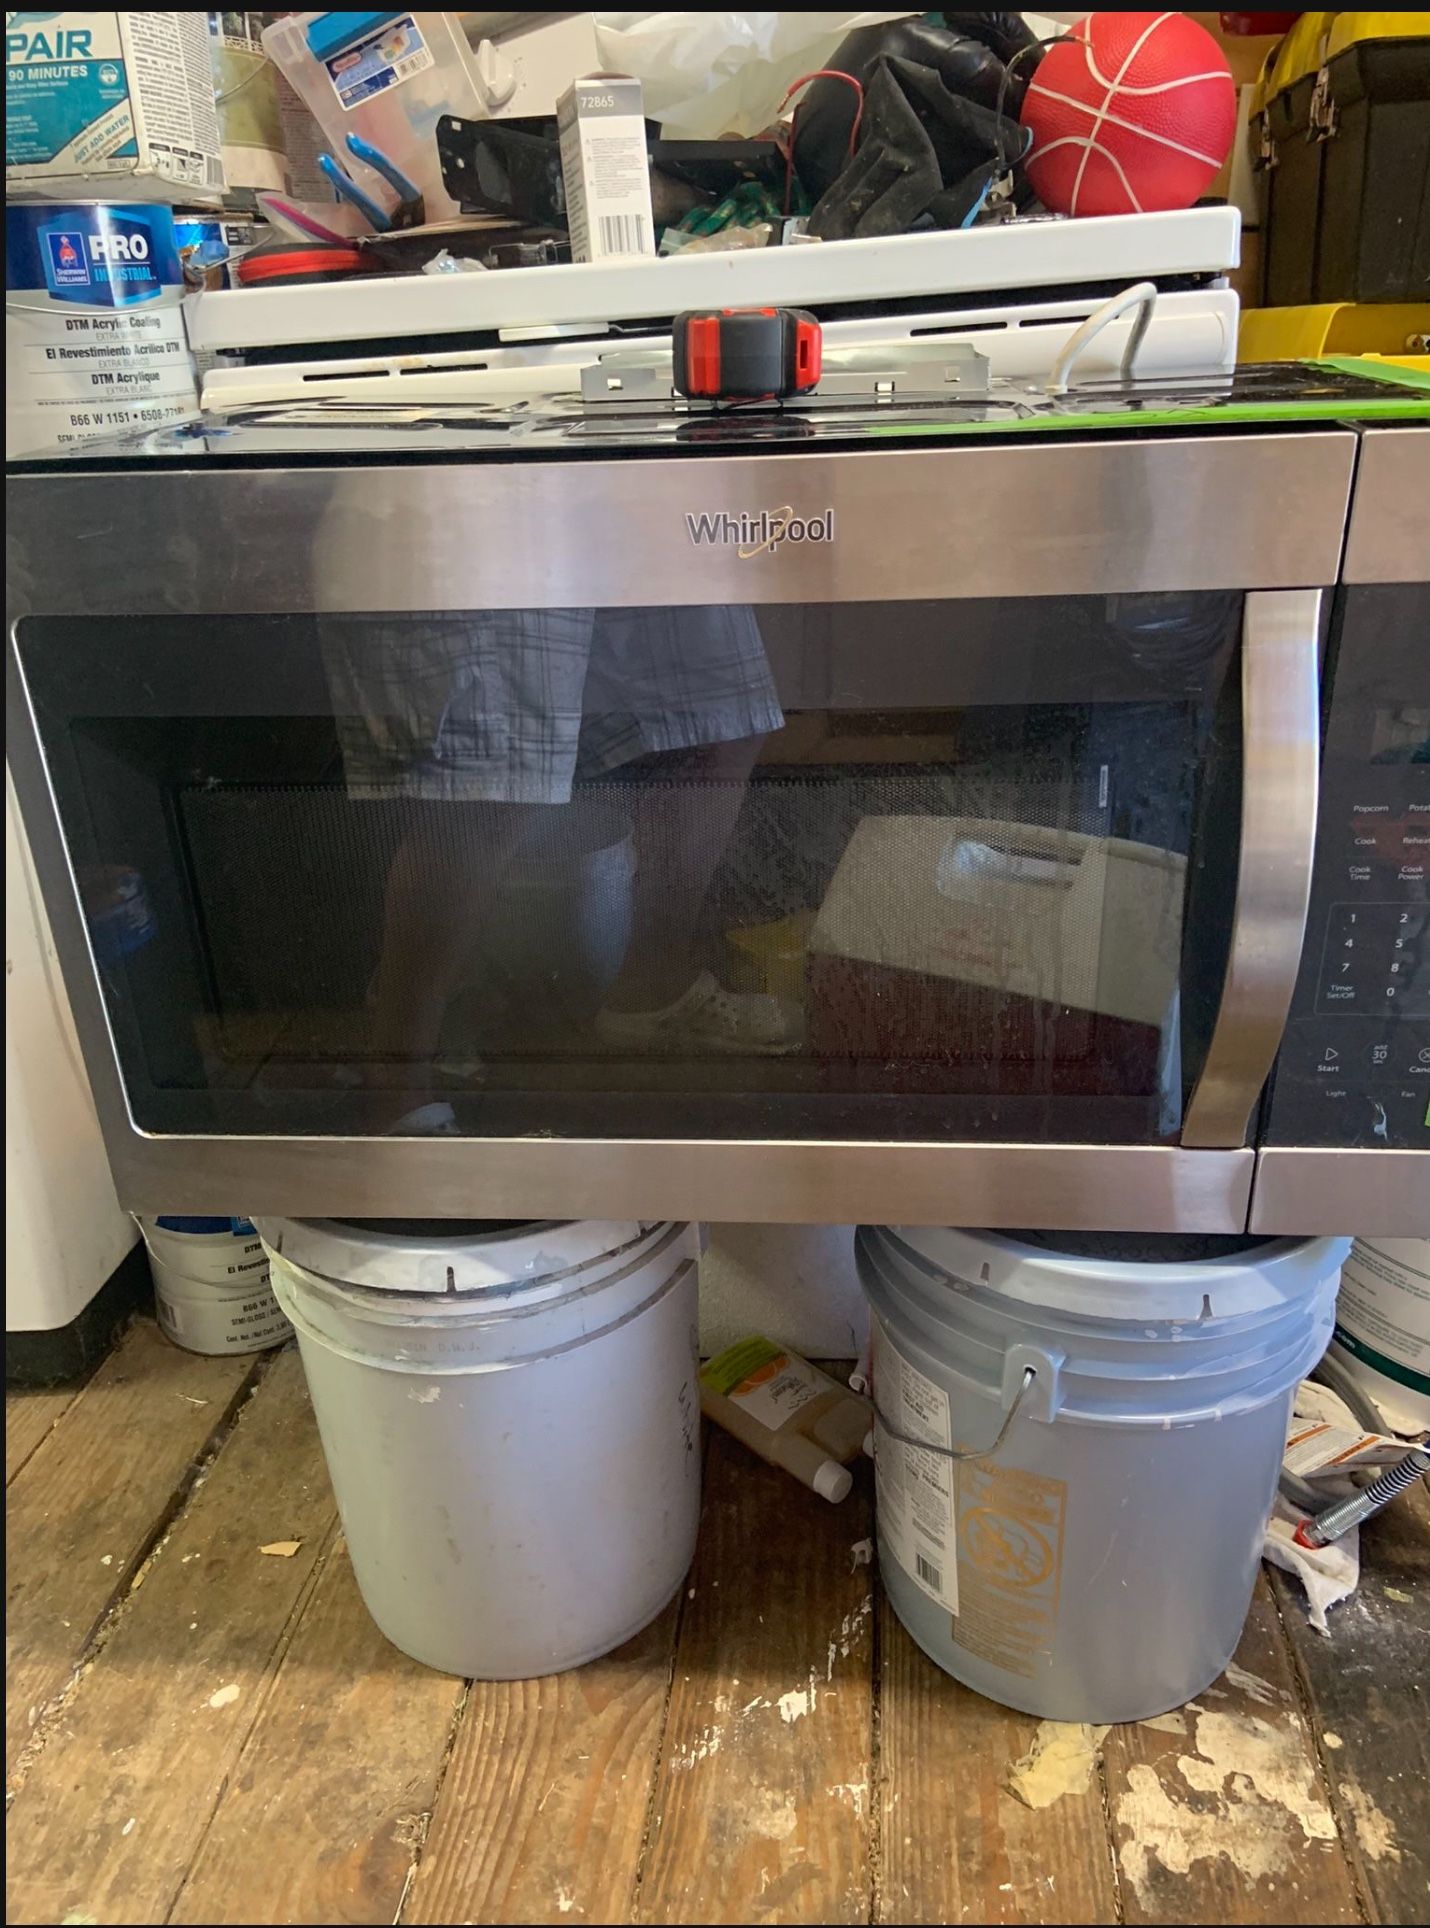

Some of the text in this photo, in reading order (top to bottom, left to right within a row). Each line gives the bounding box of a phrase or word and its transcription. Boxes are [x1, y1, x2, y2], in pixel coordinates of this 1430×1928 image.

[6, 29, 94, 62] PAIR
[8, 69, 24, 82] 90
[28, 65, 88, 80] MINUTES
[580, 95, 615, 109] 72865
[88, 234, 149, 260] PRO
[66, 319, 89, 331] DTM
[46, 349, 56, 359] El
[59, 345, 131, 359] Revestimiento
[91, 370, 160, 385] DTM Acrylique
[70, 413, 90, 426] B66
[92, 412, 104, 425] W
[106, 411, 130, 424] 1151
[685, 509, 834, 552] Whirlpool
[1353, 804, 1389, 813] Popcorn
[1354, 837, 1376, 845] Cook
[1349, 865, 1371, 873] Cook
[1401, 865, 1423, 873] Cook
[1350, 873, 1370, 881] Time
[1397, 872, 1424, 880] Power
[1351, 913, 1409, 923] 1 2
[1344, 938, 1404, 948] 4 5
[1341, 963, 1400, 973] 7 8
[1331, 984, 1354, 992] Timer
[1386, 987, 1396, 997] 0
[1372, 1050, 1388, 1060] 30
[1317, 1064, 1340, 1073] Start
[1326, 1090, 1416, 1099] Light Fan
